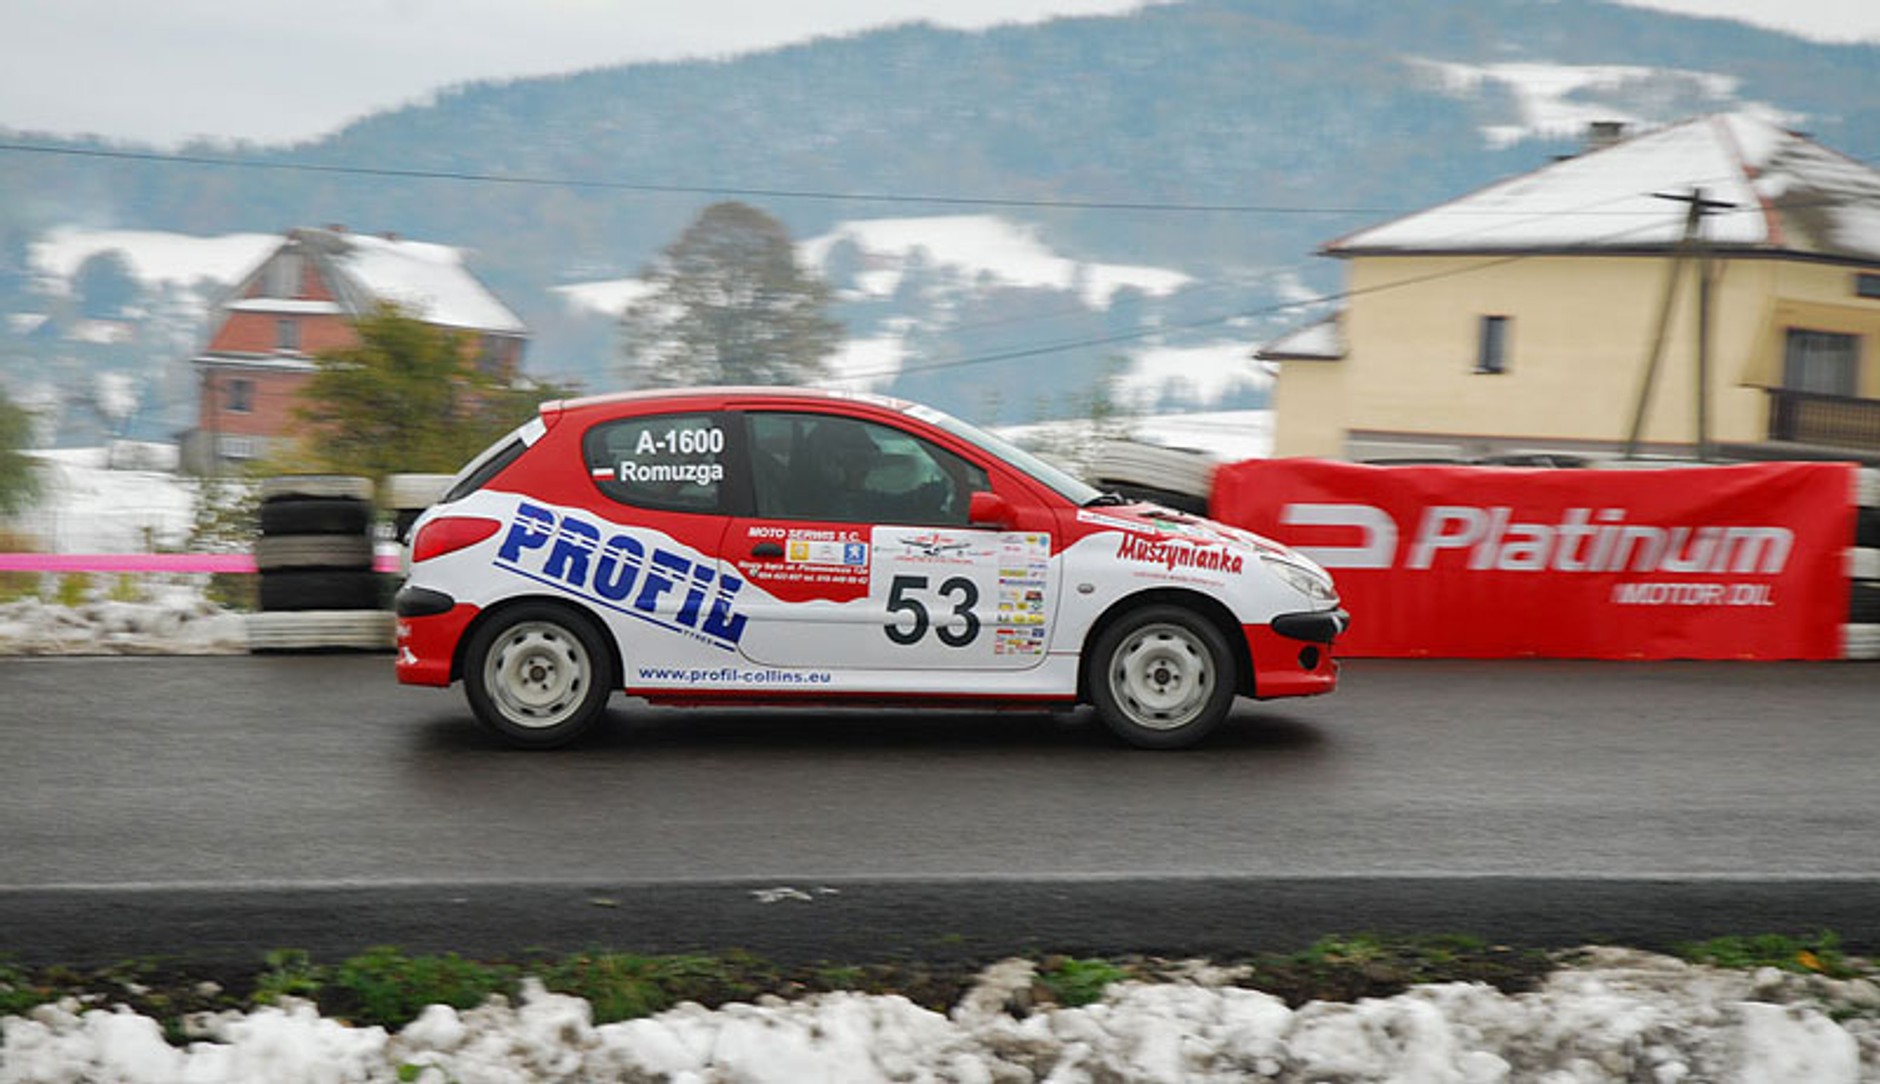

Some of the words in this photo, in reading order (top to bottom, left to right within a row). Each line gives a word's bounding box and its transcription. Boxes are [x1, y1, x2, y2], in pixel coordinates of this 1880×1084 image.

[635, 429, 724, 455] A-1600
[620, 461, 723, 485] Romuzga
[748, 527, 786, 538] MOTO
[1405, 505, 1795, 573] Platinum
[1117, 532, 1243, 574] Muszynianka
[498, 502, 749, 643] PROFIL
[1612, 583, 1726, 605] MOTOR
[884, 575, 980, 647] 53
[639, 668, 832, 684] www.profil-collins.eu
